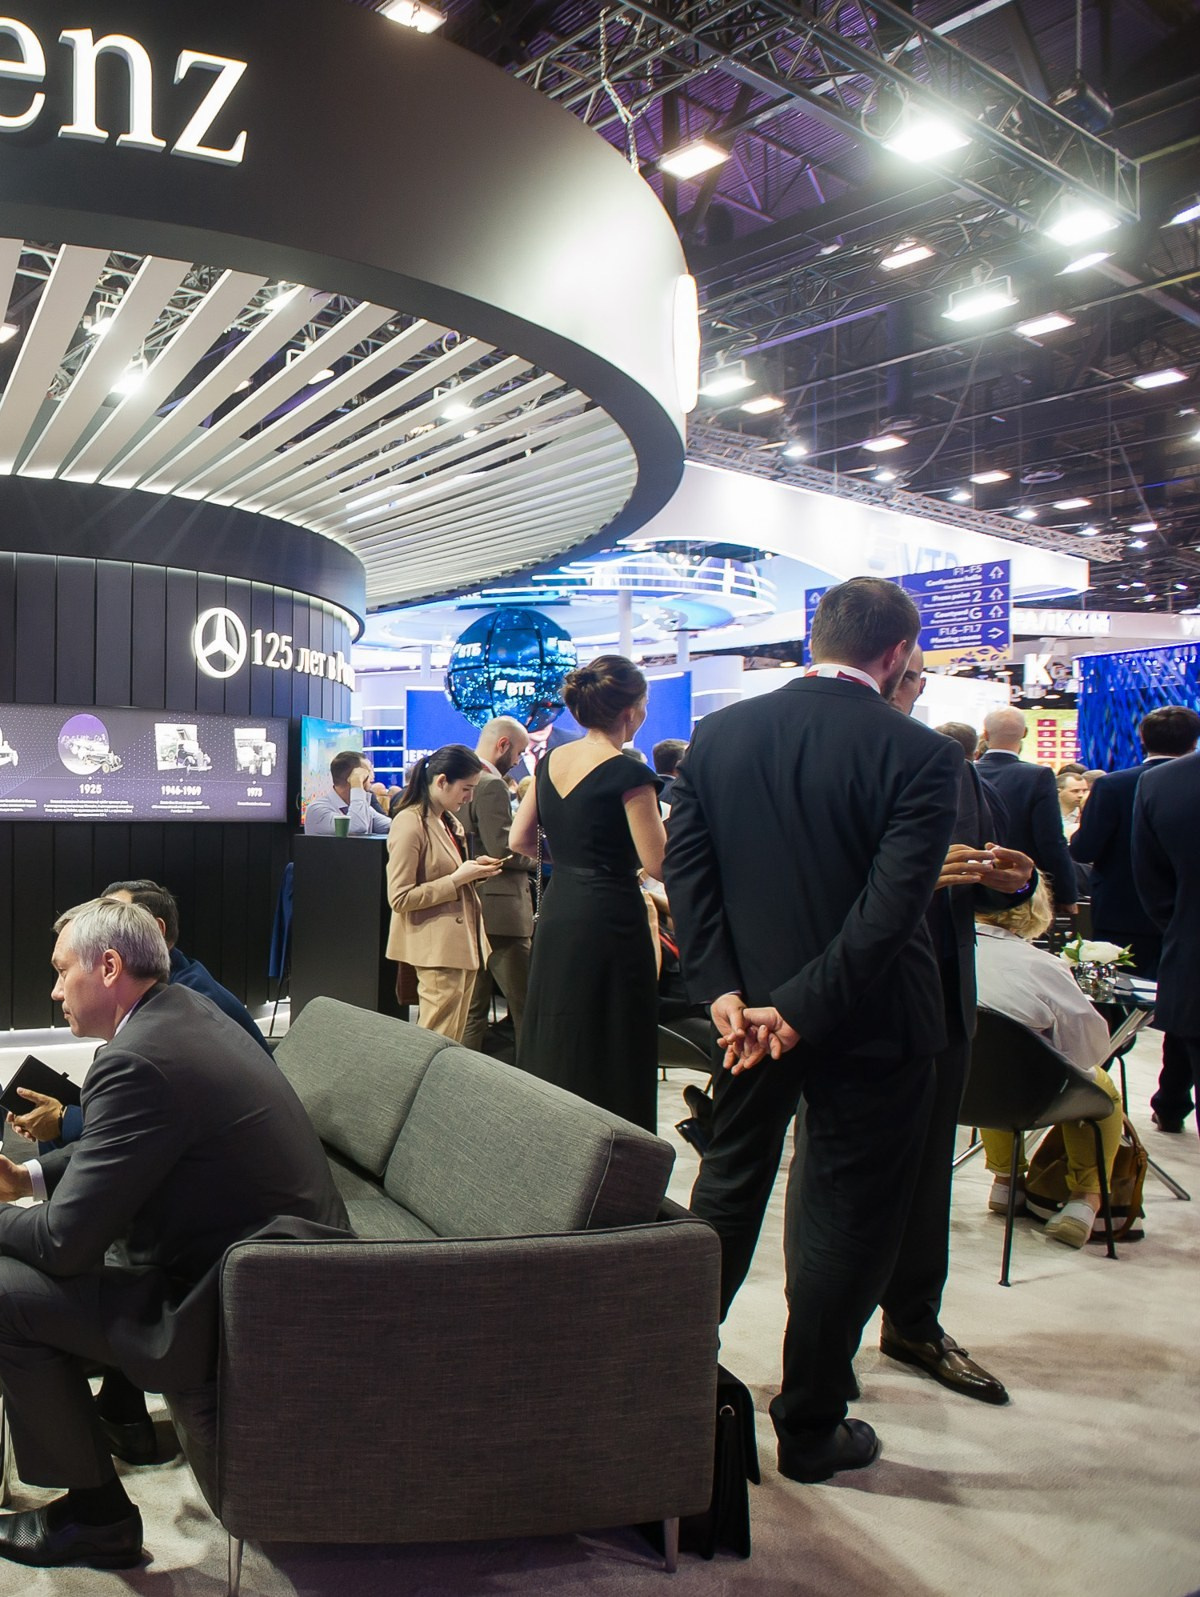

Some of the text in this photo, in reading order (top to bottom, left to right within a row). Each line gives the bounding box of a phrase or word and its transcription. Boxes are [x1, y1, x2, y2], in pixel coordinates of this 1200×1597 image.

[972, 590, 983, 603] 2
[969, 607, 983, 620] G
[251, 628, 293, 671] 125
[295, 647, 327, 678] лет
